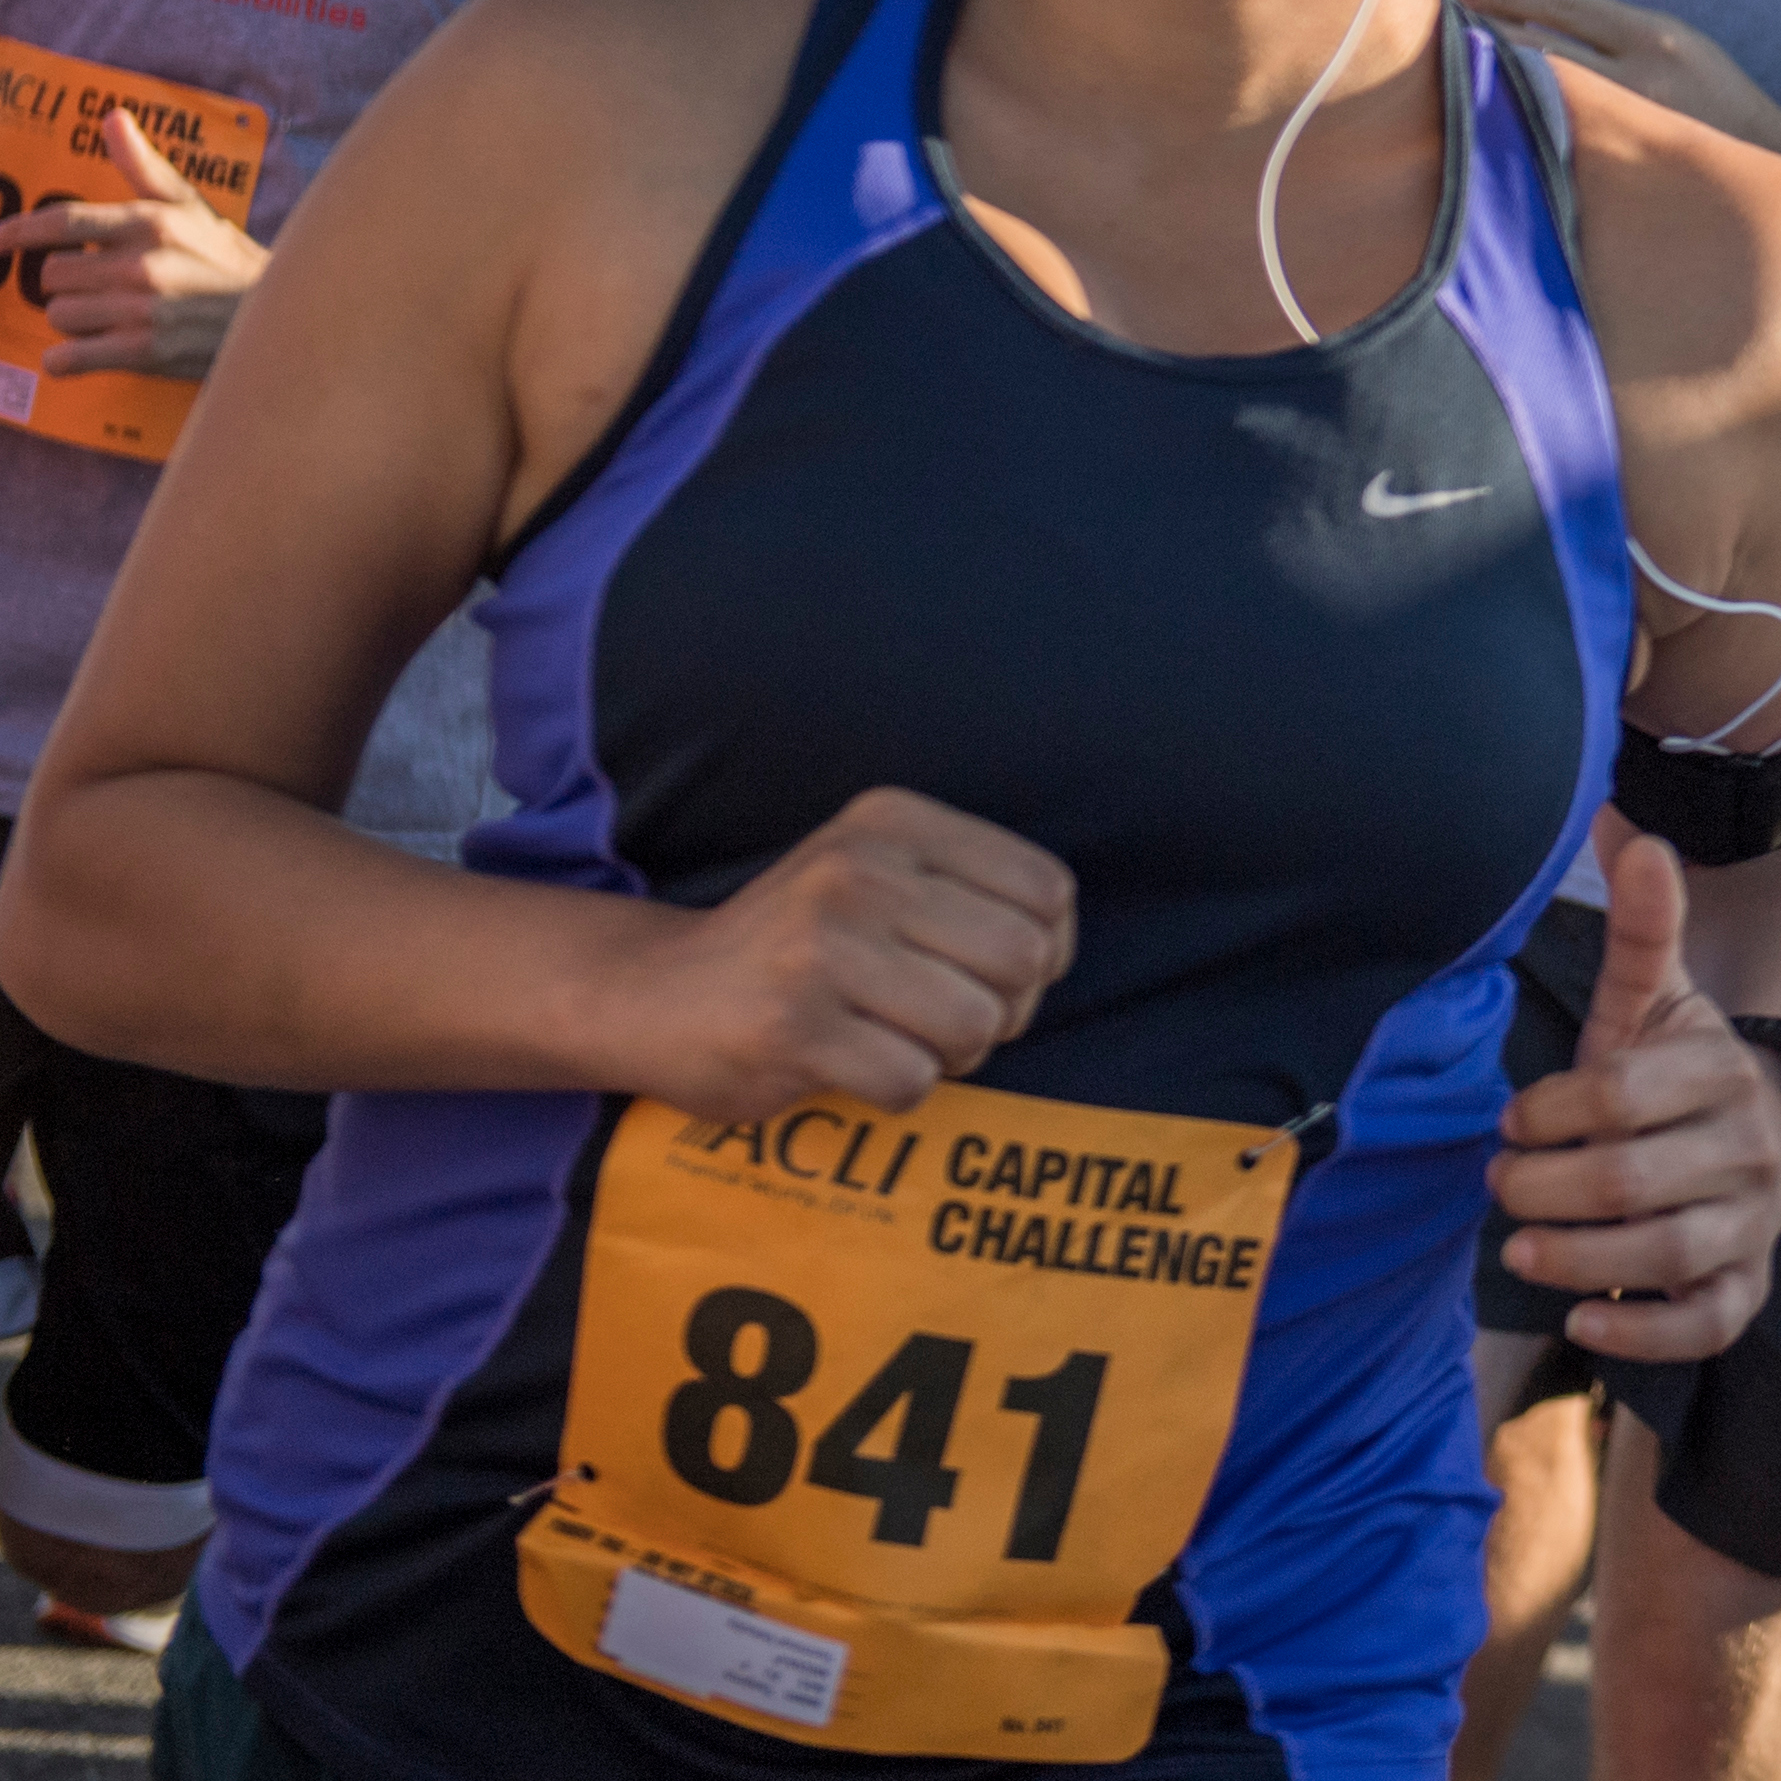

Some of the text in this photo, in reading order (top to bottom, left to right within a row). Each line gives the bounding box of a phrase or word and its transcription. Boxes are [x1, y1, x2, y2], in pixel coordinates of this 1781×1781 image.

[702, 1108, 1188, 1217] ACLI CAPITAL
[928, 1199, 1263, 1294] CHALLENGE
[661, 1284, 1116, 1565] 841
